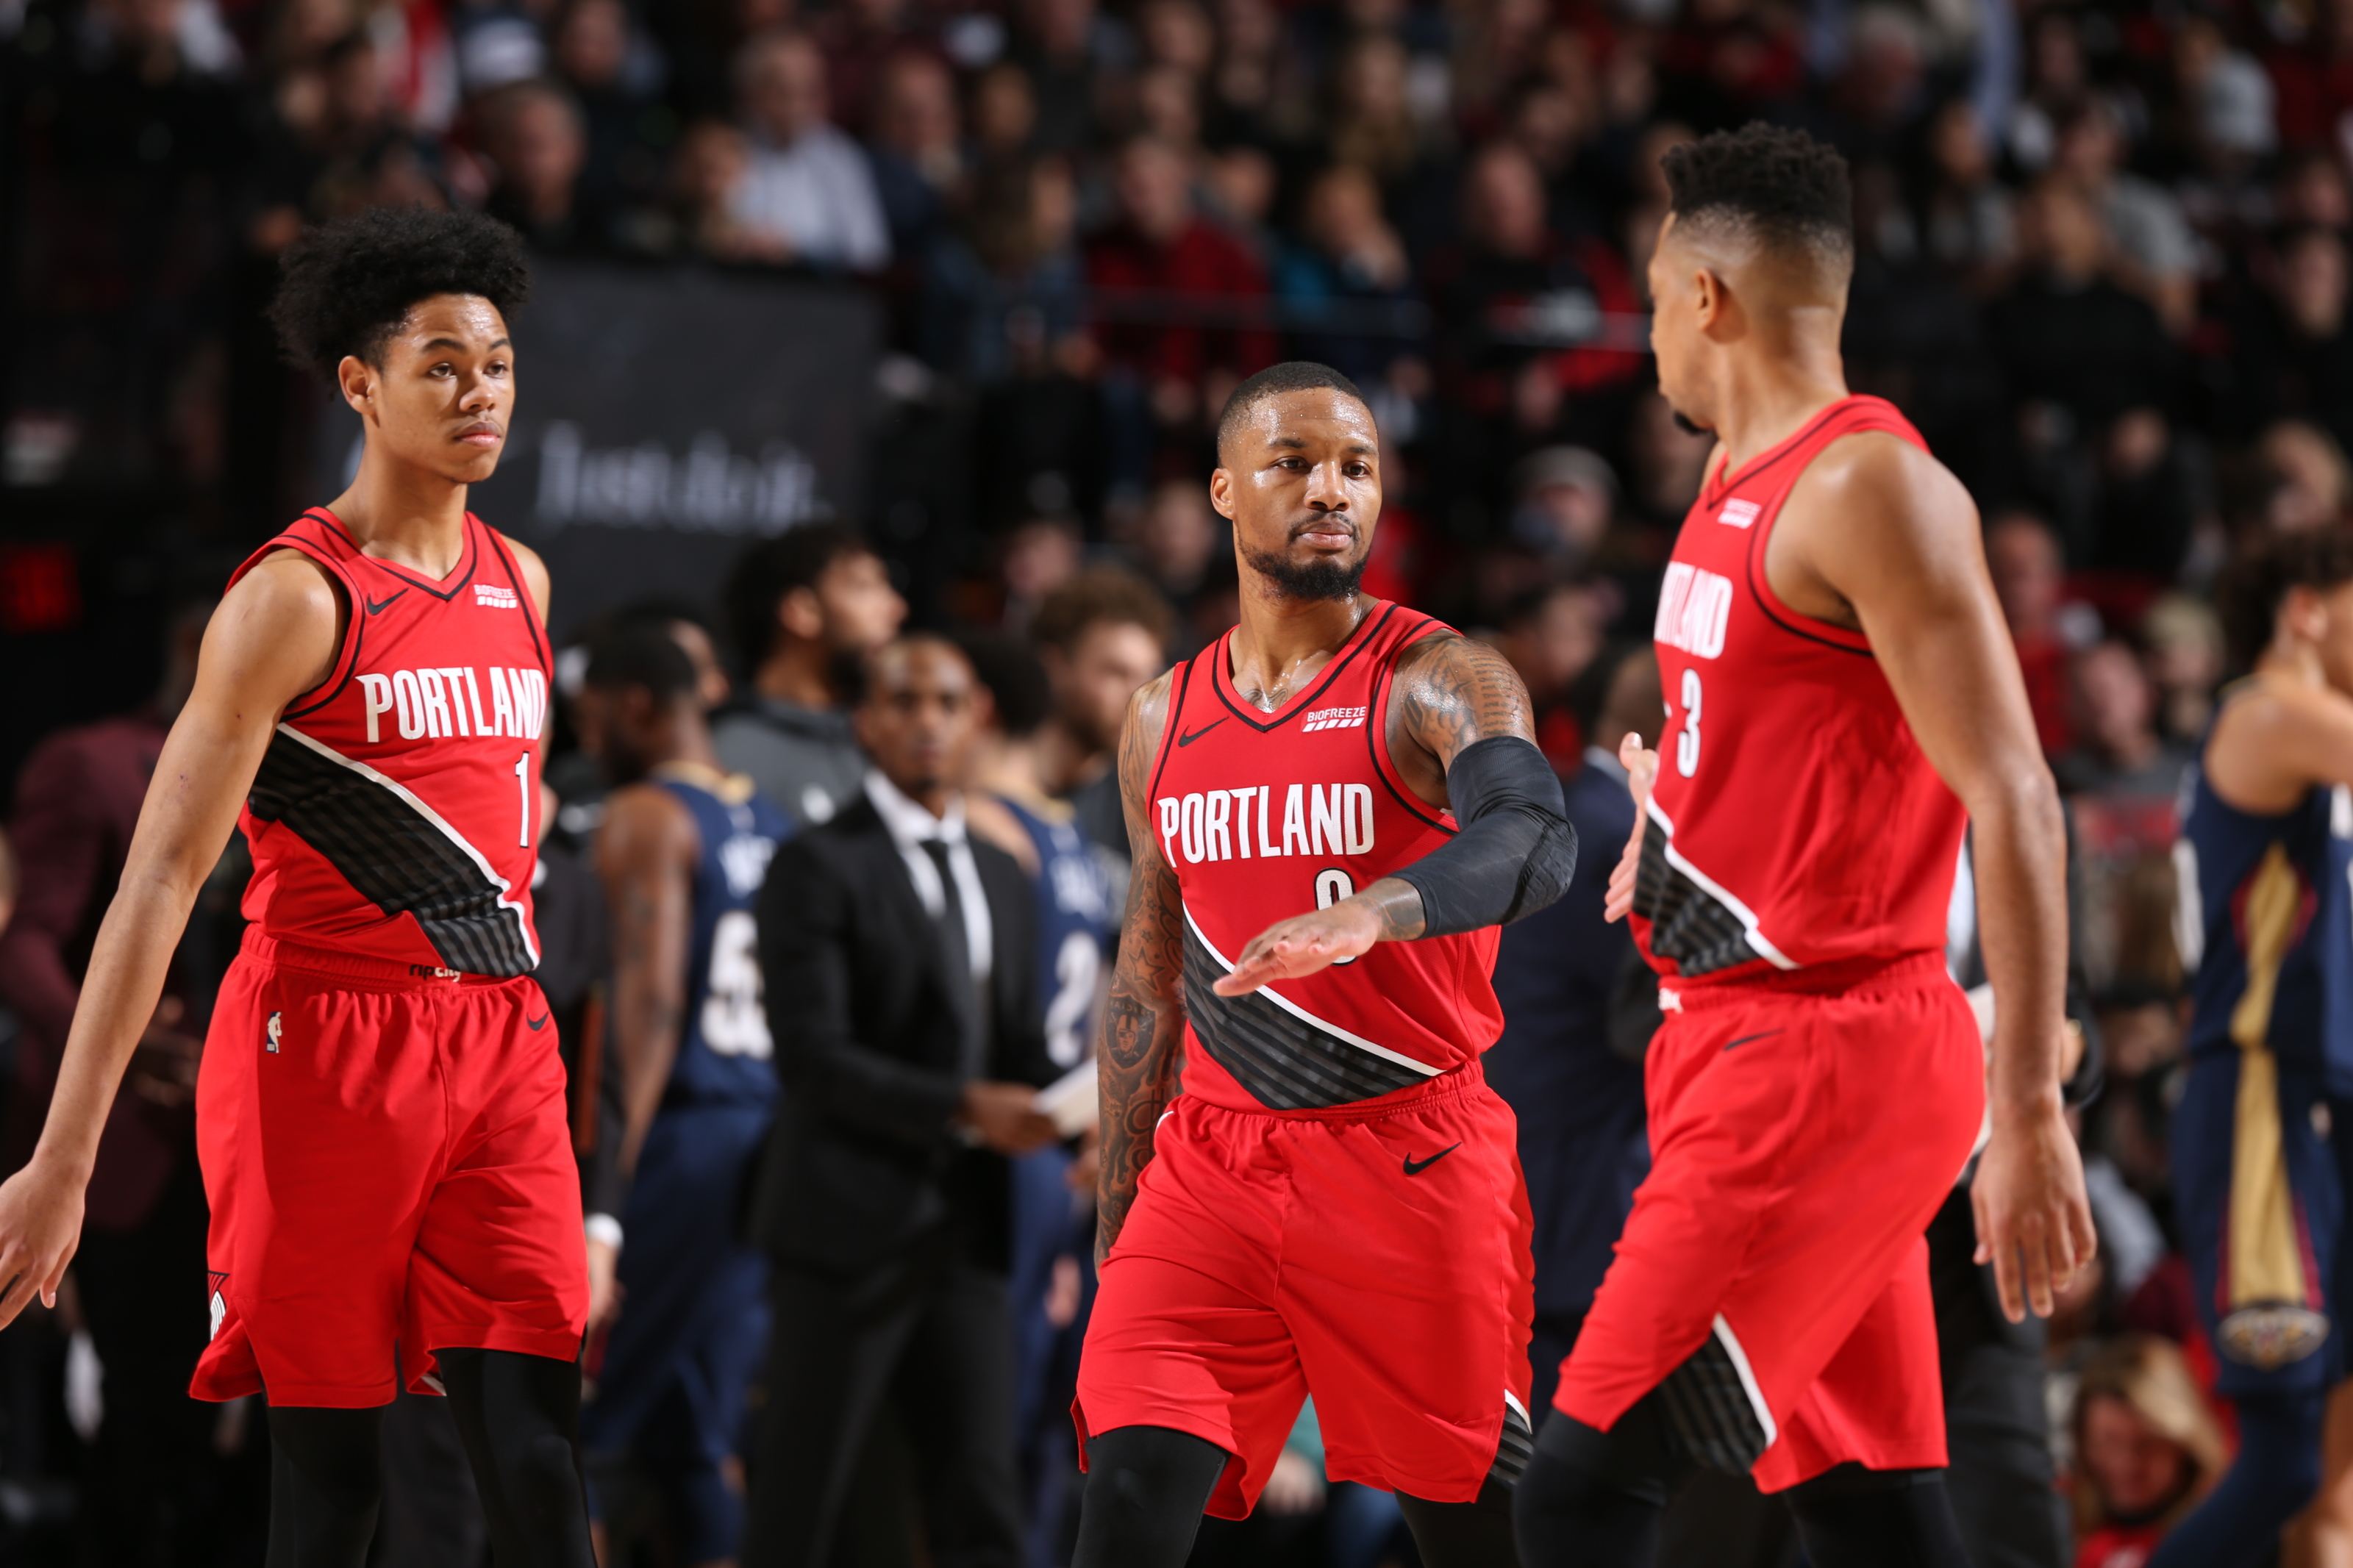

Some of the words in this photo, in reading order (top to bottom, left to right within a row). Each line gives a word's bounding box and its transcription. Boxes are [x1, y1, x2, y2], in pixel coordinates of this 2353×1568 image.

[354, 666, 548, 742] PORTLAND
[1677, 668, 1702, 778] 3
[515, 750, 529, 848] 1
[1157, 783, 1374, 868] PORTLAND
